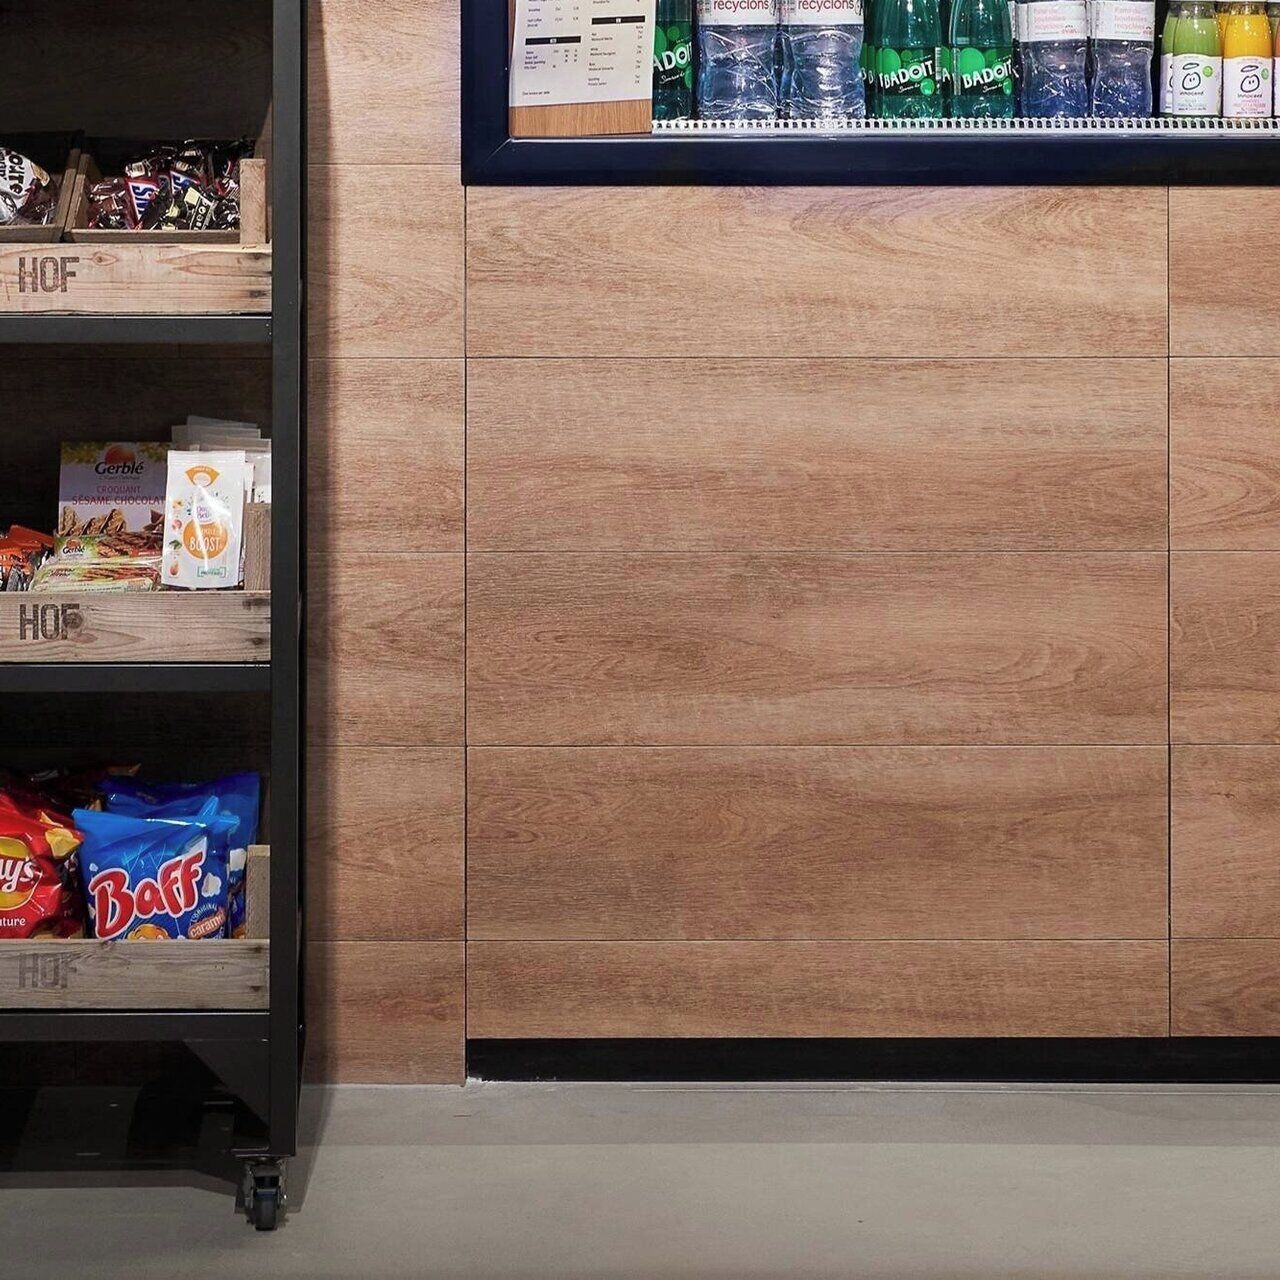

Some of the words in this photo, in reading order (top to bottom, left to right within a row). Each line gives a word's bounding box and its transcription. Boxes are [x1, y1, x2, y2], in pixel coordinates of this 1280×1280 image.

[883, 59, 934, 85] BADOIT
[962, 60, 1013, 88] BADOIT
[19, 257, 80, 294] HOF
[95, 461, 144, 475] Gerblé
[72, 495, 111, 506] SÉSAME
[114, 496, 166, 506] CHOCOLAT
[96, 485, 141, 495] CROQUANT
[62, 545, 87, 556] Gerblé
[19, 603, 81, 641] HOF
[19, 951, 77, 988] HOF
